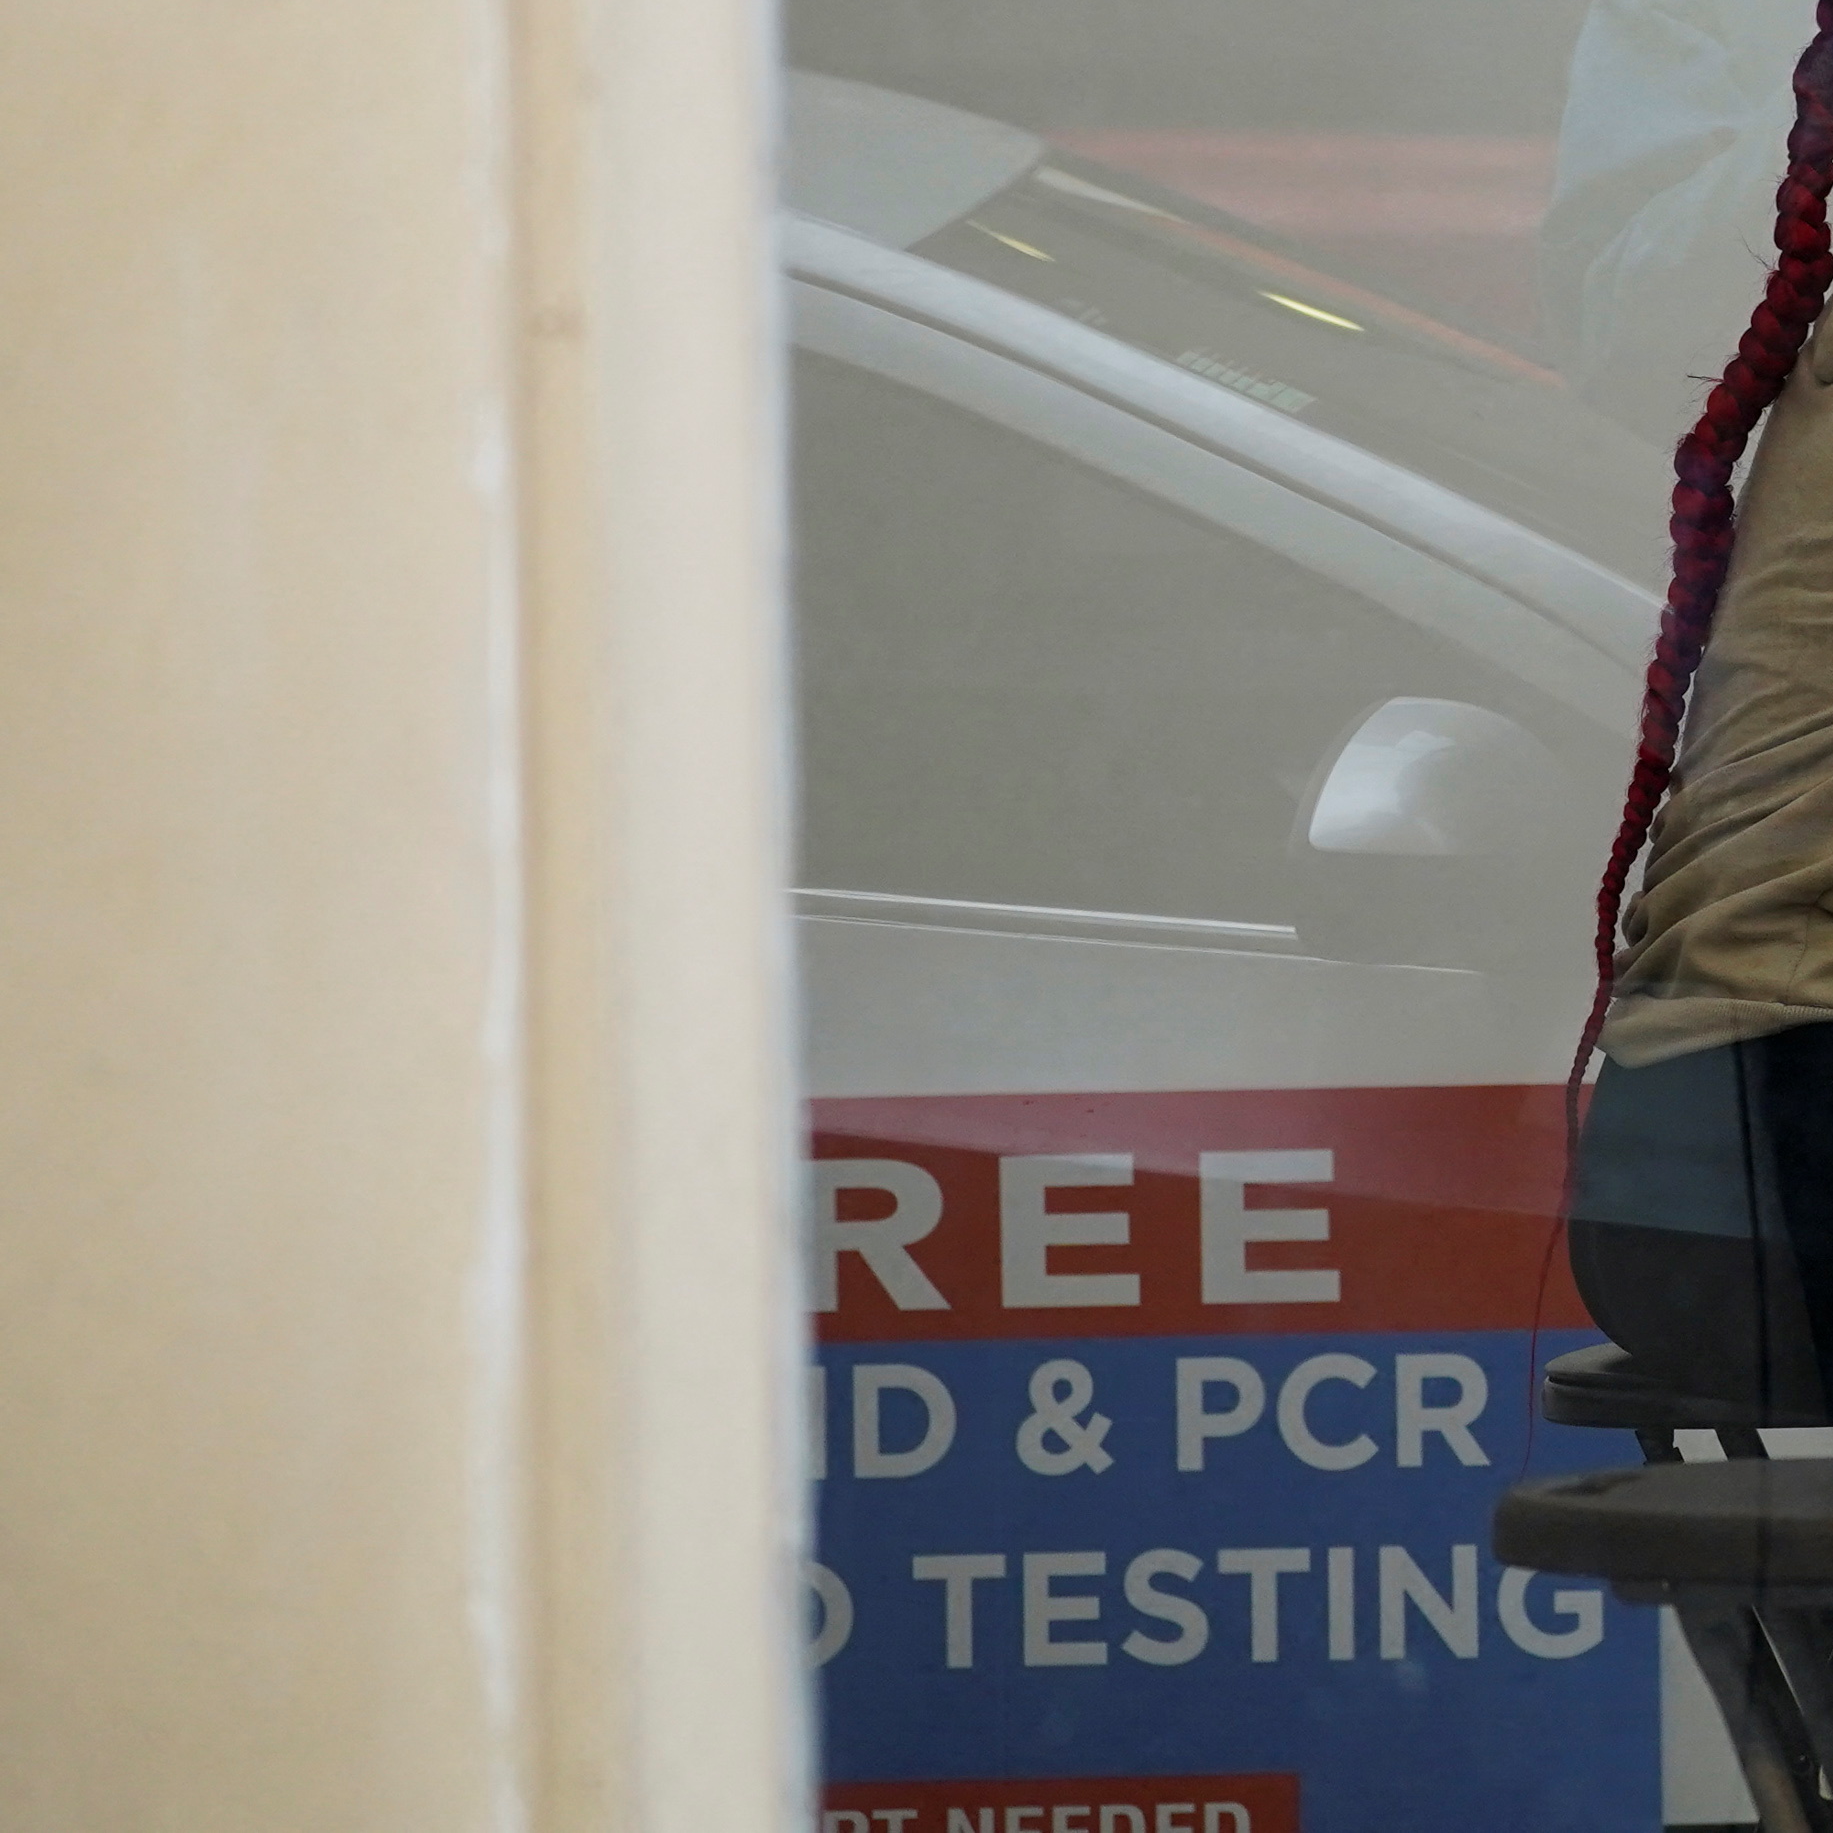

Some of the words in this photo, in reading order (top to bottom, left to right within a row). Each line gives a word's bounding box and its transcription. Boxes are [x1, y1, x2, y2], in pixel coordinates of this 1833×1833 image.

[1015, 1357, 1114, 1476] &
[1175, 1352, 1491, 1473] PCR
[912, 1543, 1605, 1669] TESTING
